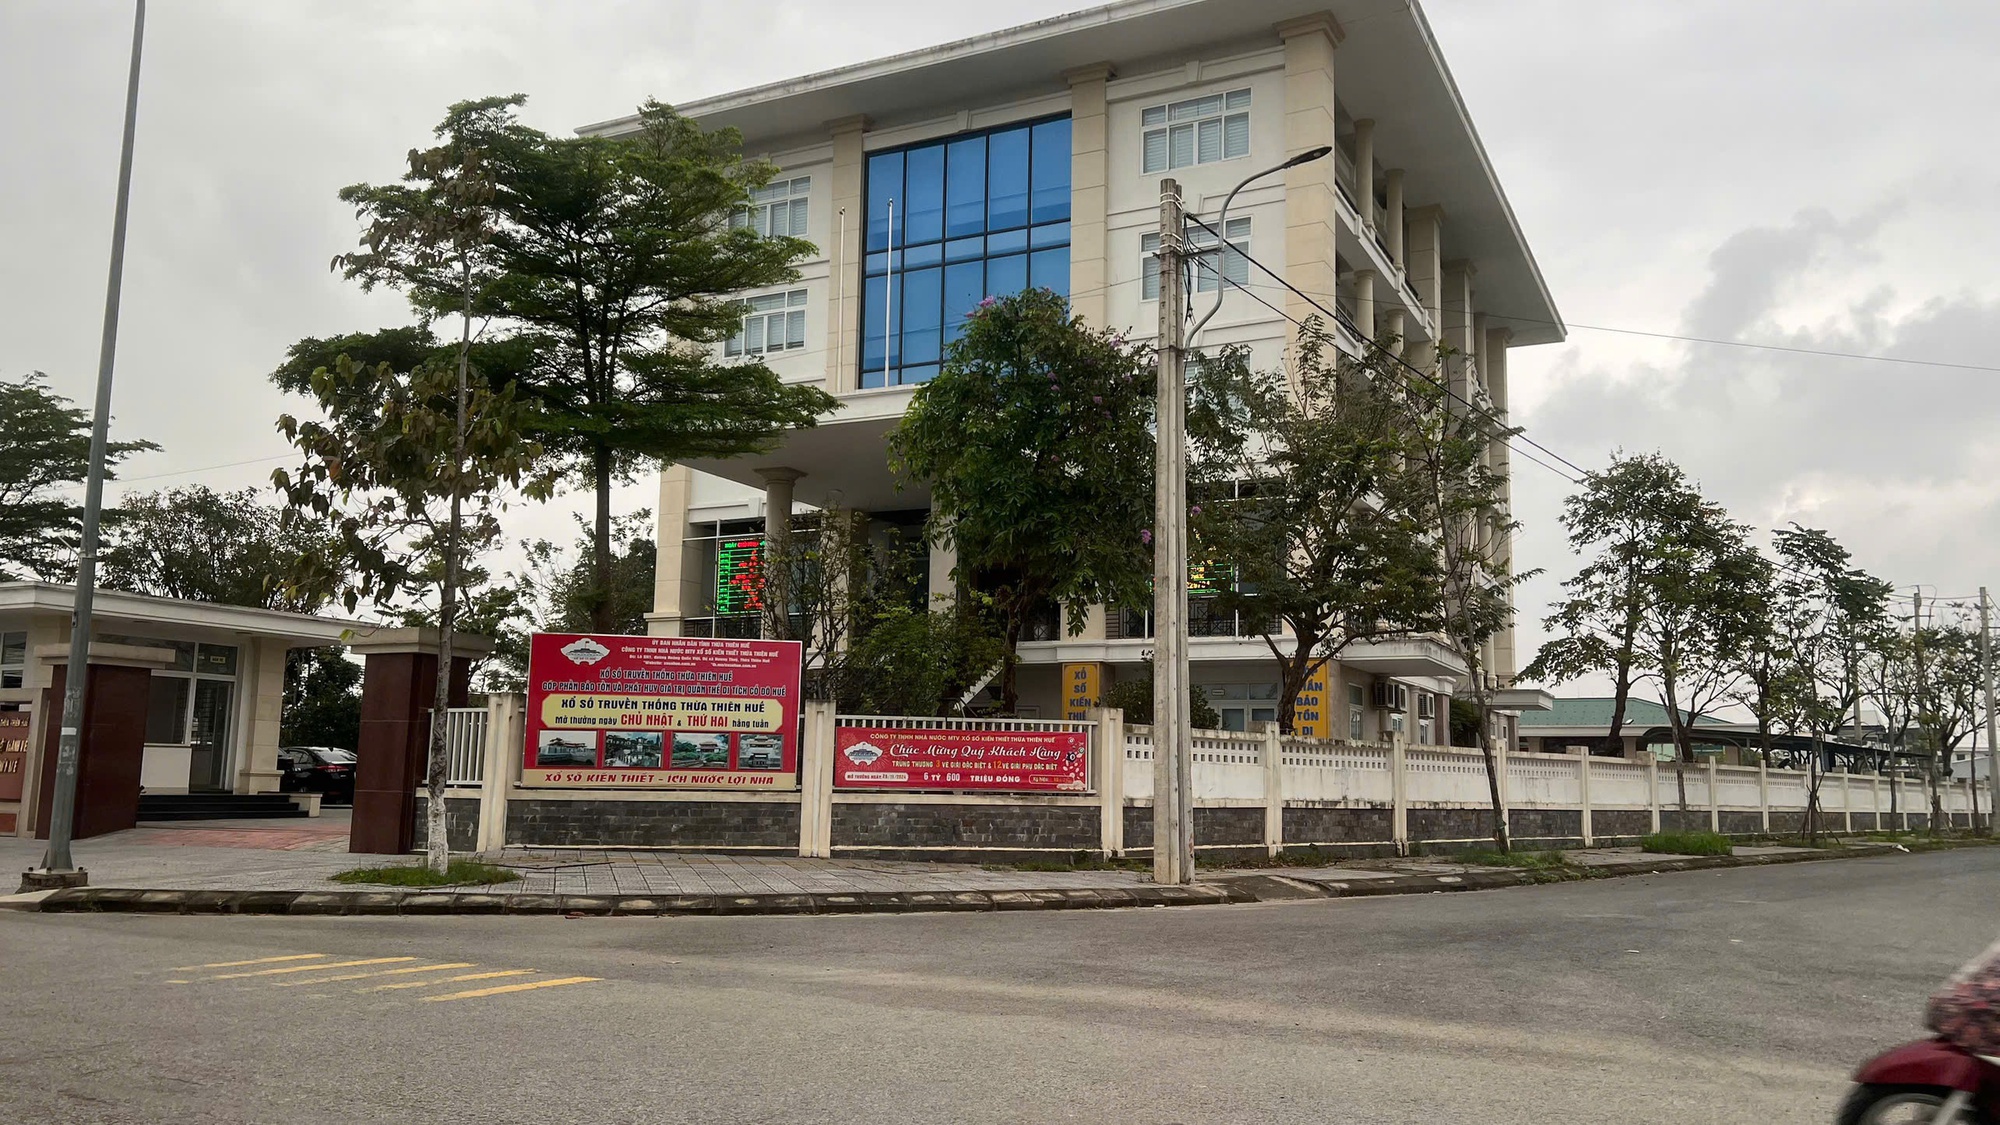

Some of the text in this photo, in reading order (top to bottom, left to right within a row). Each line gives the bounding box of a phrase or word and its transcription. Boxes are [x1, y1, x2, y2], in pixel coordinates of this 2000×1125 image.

[600, 667, 733, 681] XỔ SỐ TRUYỀN THỐNG THỪA THIÊN HUẾ
[1075, 667, 1087, 680] XỔ
[542, 679, 786, 697] GÓP PHẦN BẢO TỒN VÀ PHÁT HUY GIÁ TRỊ QUẦN THỂ DI TÍCH CỐ ĐÔ HUẾ
[1074, 682, 1086, 693] SỐ
[562, 696, 765, 713] XỔ SỐ TRUYỀN THỐNG THỪA THIÊN HUẾ
[1070, 696, 1091, 707] KIẾN
[1296, 695, 1318, 706] BẢO
[555, 714, 568, 724] Mở
[570, 716, 596, 726] thưởng
[599, 716, 617, 726] ngày
[621, 712, 643, 726] CHỦ
[647, 713, 673, 728] NHẬT
[687, 713, 707, 727] THỨ
[711, 716, 728, 727] HAI
[753, 718, 769, 728] tuần
[1297, 709, 1319, 721] TỒN
[890, 744, 1061, 760] Chúc Mừng Quý Khách Hàng
[936, 760, 940, 768] 3
[994, 761, 1002, 769] 12
[545, 771, 562, 782] XỔ
[567, 771, 582, 782] SỐ
[587, 772, 617, 782] KIẾN
[621, 772, 654, 783] THIẾT
[691, 774, 724, 784] NƯỚC
[728, 775, 747, 785] LỢI
[924, 772, 928, 780] 6
[946, 773, 960, 781] 600
[970, 775, 993, 783] TRIỆU
[996, 774, 1020, 783] ĐỒNG
